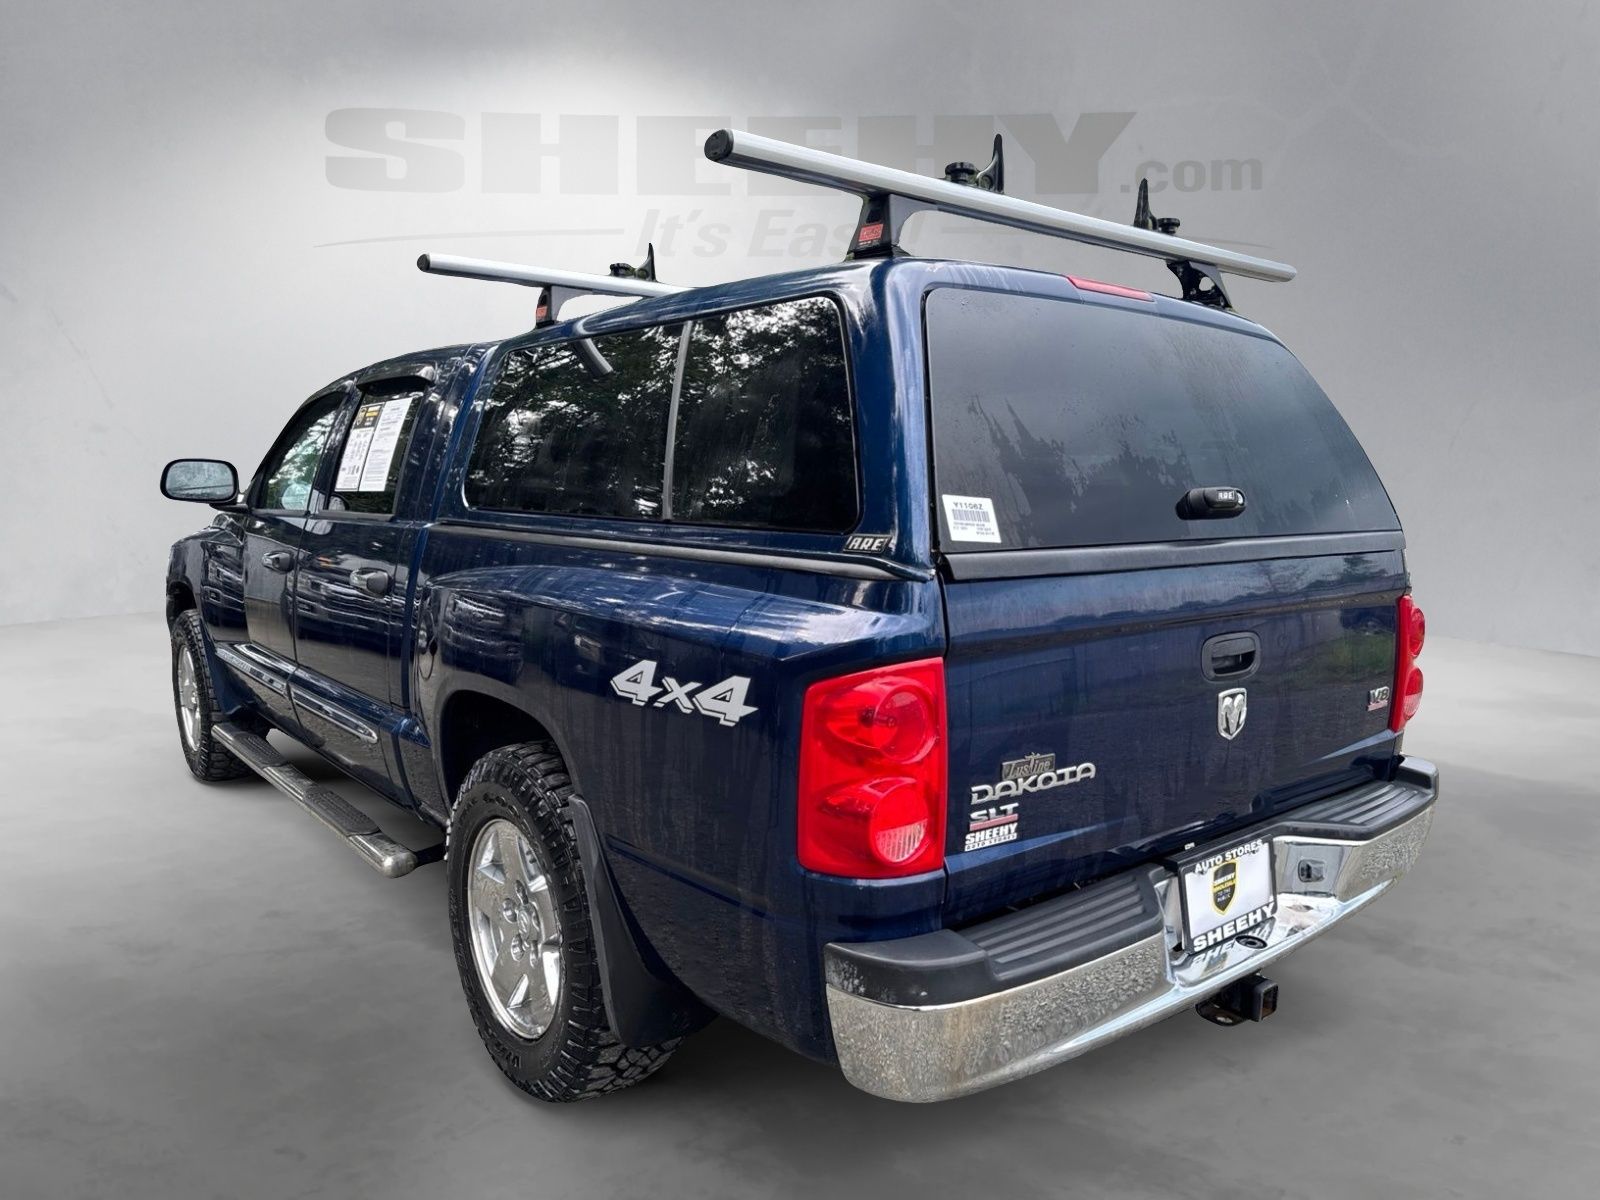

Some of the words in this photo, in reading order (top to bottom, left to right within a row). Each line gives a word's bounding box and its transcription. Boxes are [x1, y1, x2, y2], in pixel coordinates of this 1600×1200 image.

[634, 208, 731, 257] It's
[747, 209, 926, 257] Eas!
[1370, 686, 1390, 704] V8
[970, 762, 1096, 805] DAKOTA
[970, 802, 1019, 822] SLT
[965, 822, 1018, 845] SHEEHY
[1194, 855, 1223, 873] AUTO
[1225, 839, 1263, 860] STORES
[1193, 902, 1275, 952] SHEEHY
